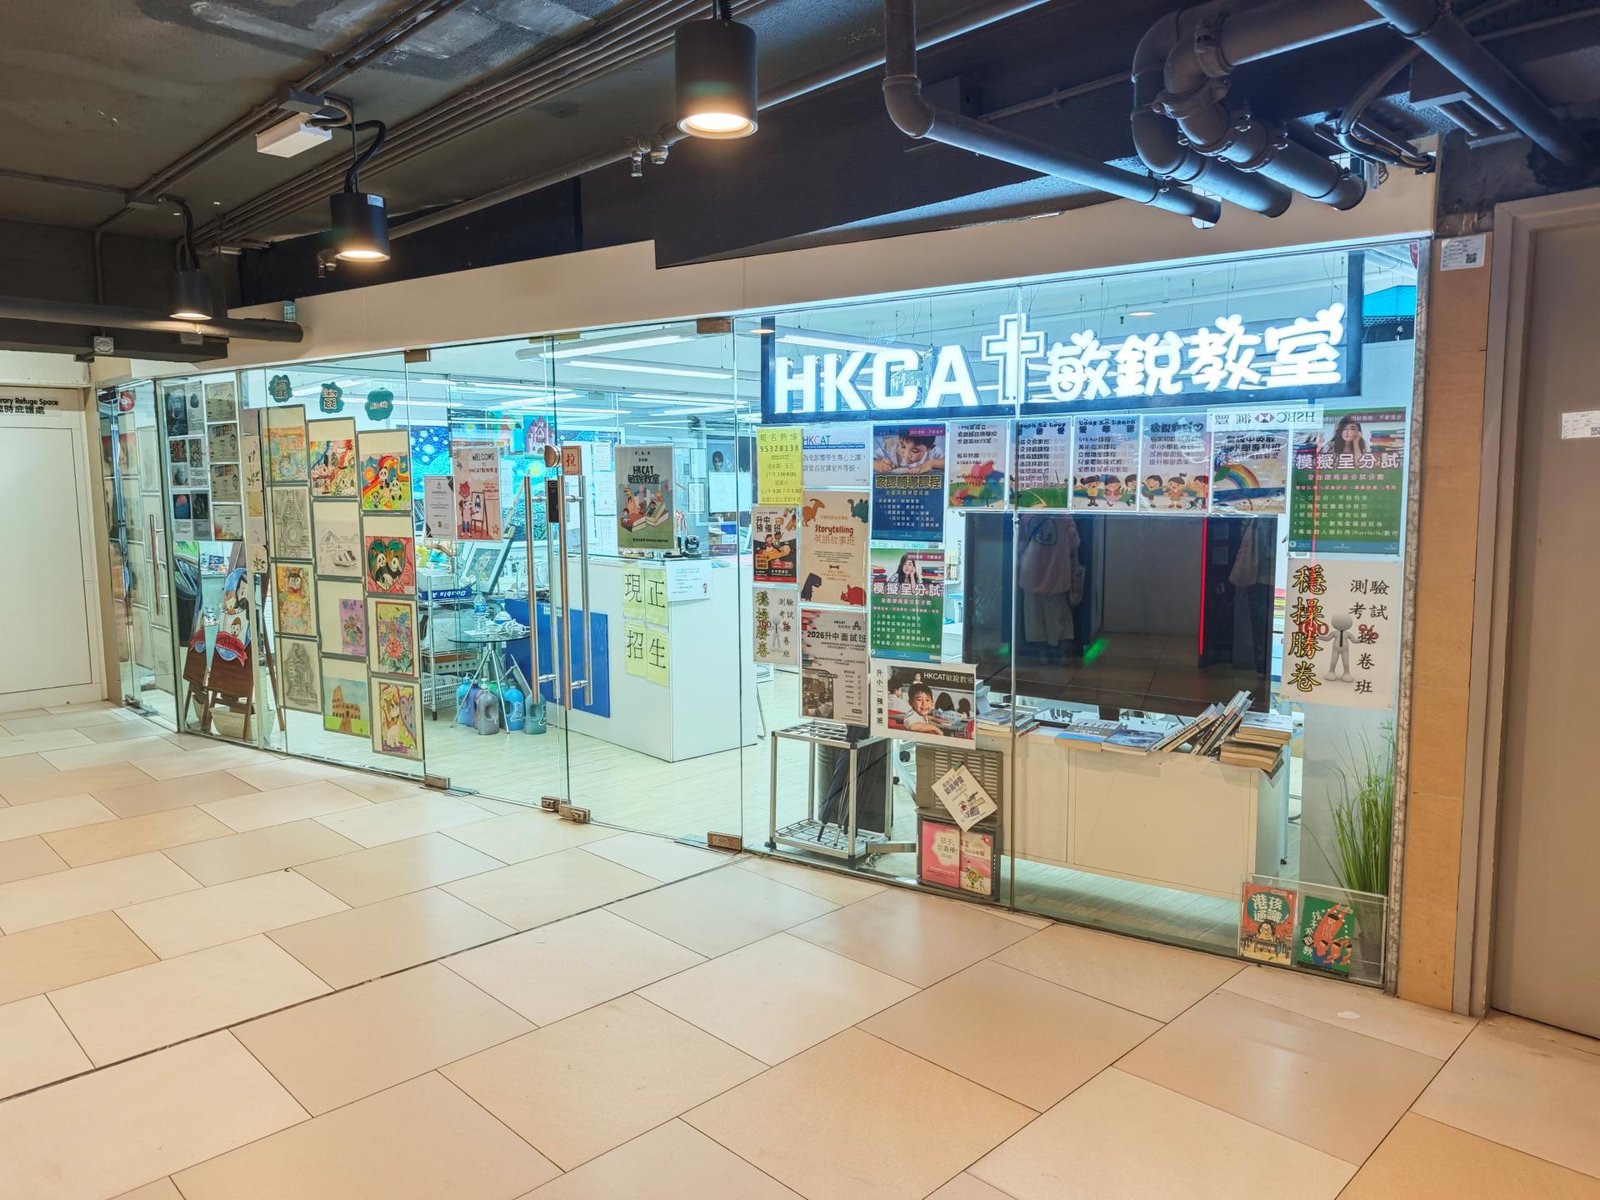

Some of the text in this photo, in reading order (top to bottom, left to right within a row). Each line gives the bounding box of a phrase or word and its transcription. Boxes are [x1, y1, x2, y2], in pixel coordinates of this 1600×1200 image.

[1046, 302, 1346, 401] 敏銳教室
[15, 397, 38, 406] Refuge
[39, 398, 59, 406] Space
[802, 435, 831, 445] HKCAT
[1296, 452, 1399, 470] 模擬呈分試
[632, 465, 654, 474] HKCAT
[815, 524, 854, 536] Storytelling
[873, 582, 941, 597] 模擬呈分試
[1350, 579, 1390, 596] 測驗
[1348, 601, 1389, 621] 考試
[1288, 563, 1327, 693] 穩操勝卷
